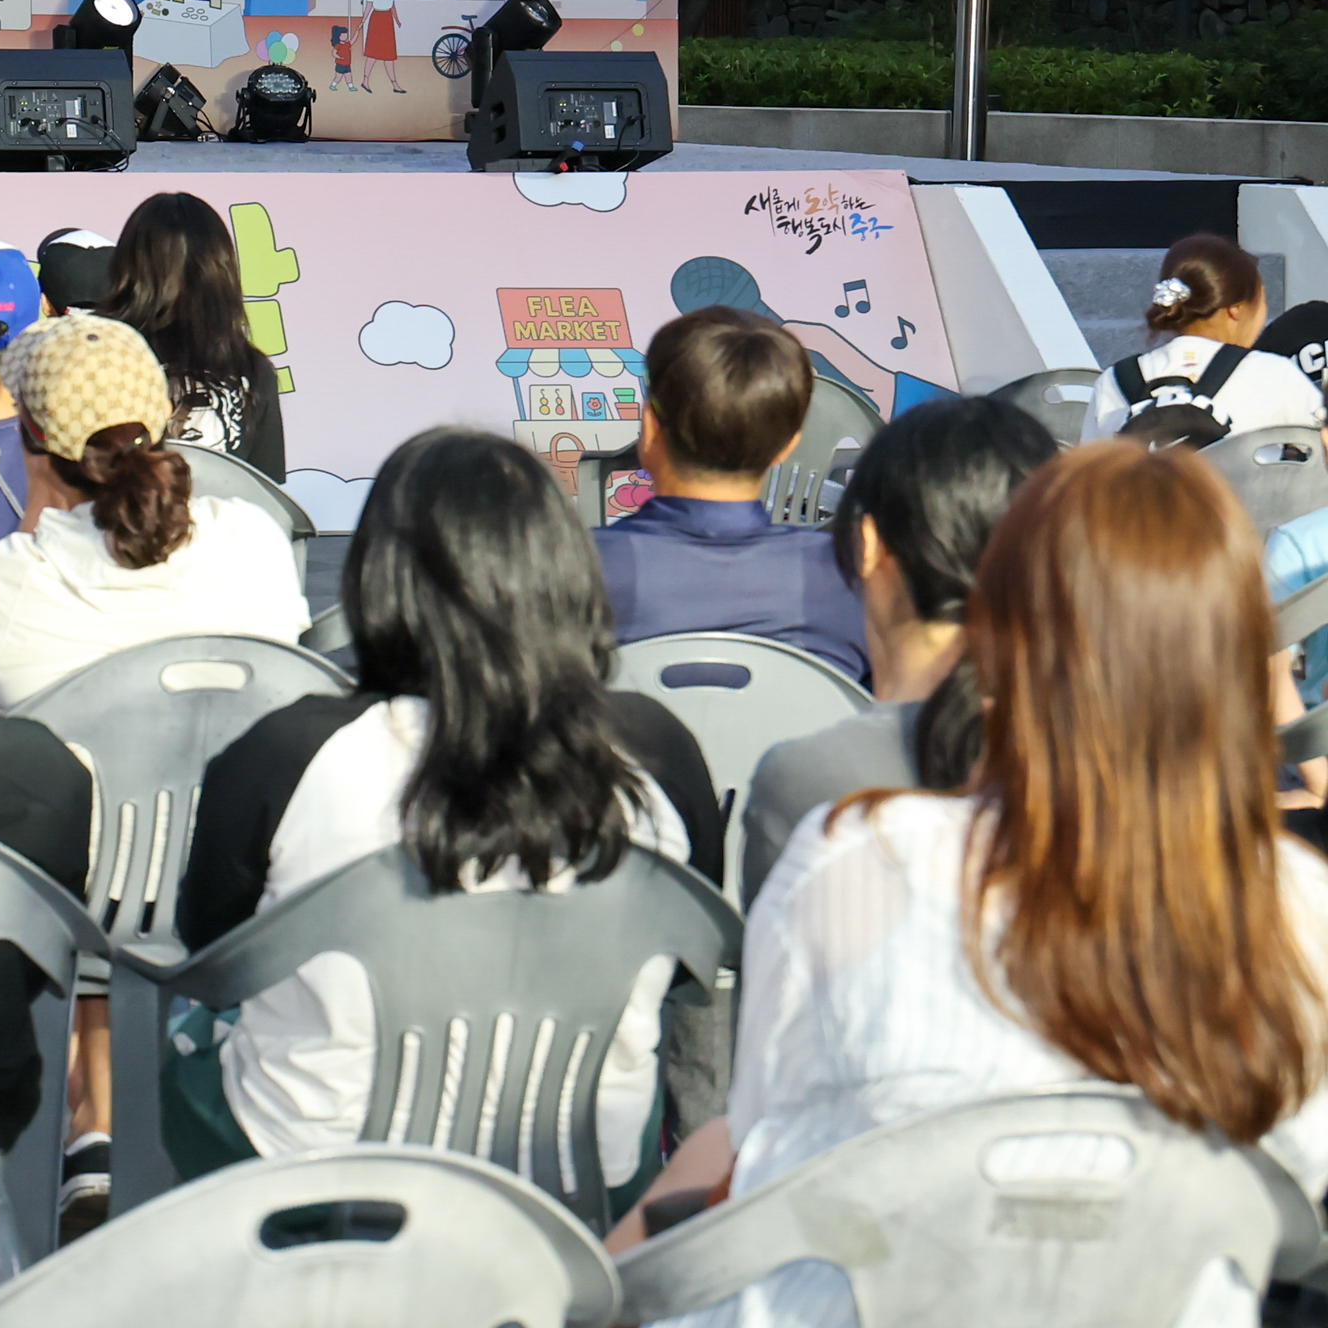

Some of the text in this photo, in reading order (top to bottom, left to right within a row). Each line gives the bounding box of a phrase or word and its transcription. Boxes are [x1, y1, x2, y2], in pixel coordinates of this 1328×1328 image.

[775, 212, 895, 255] 행복도시 중구
[526, 294, 600, 319] FLEA
[513, 319, 623, 344] MARKET
